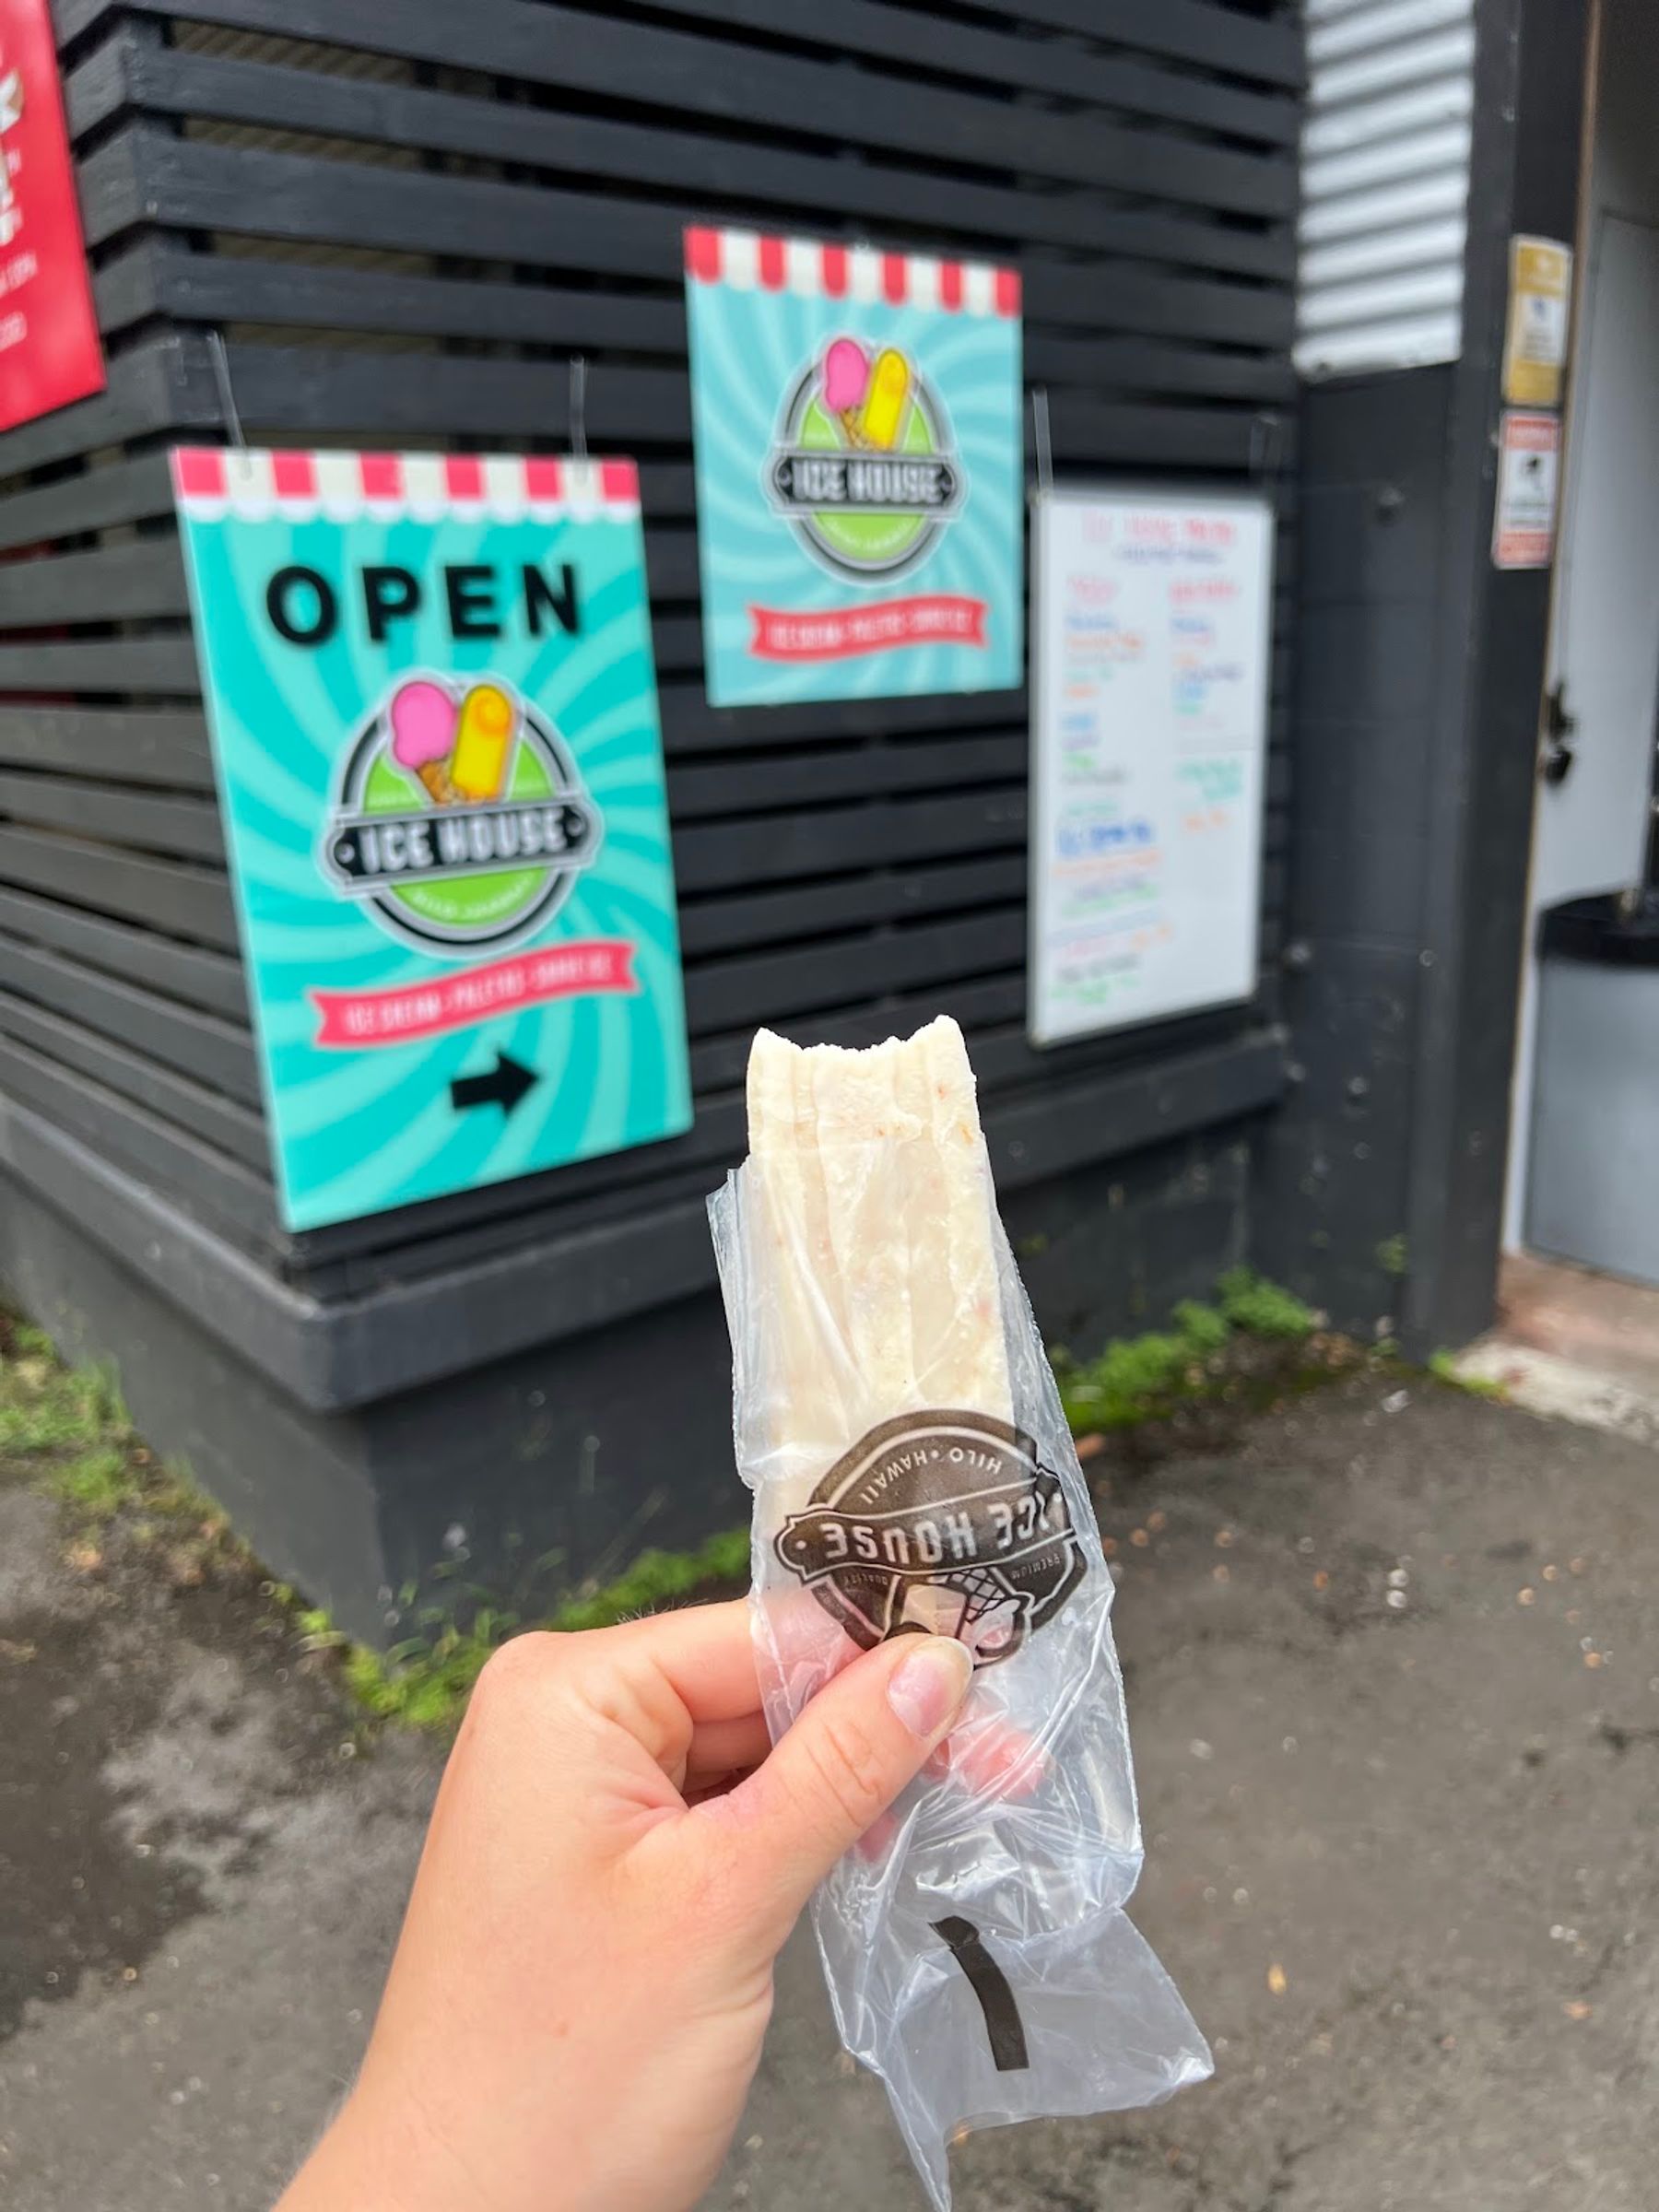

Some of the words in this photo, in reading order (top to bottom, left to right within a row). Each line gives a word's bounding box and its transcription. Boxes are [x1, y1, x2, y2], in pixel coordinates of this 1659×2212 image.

[793, 460, 846, 501] ICE
[848, 461, 944, 504] HOUSE
[266, 564, 581, 646] OPEN
[358, 819, 434, 875] ICE
[437, 805, 567, 865] HOUSE
[859, 1450, 928, 1505] HAWAII
[949, 1447, 1003, 1475] HILO
[819, 1512, 977, 1564] HOUSE
[987, 1490, 1049, 1550] ICE
